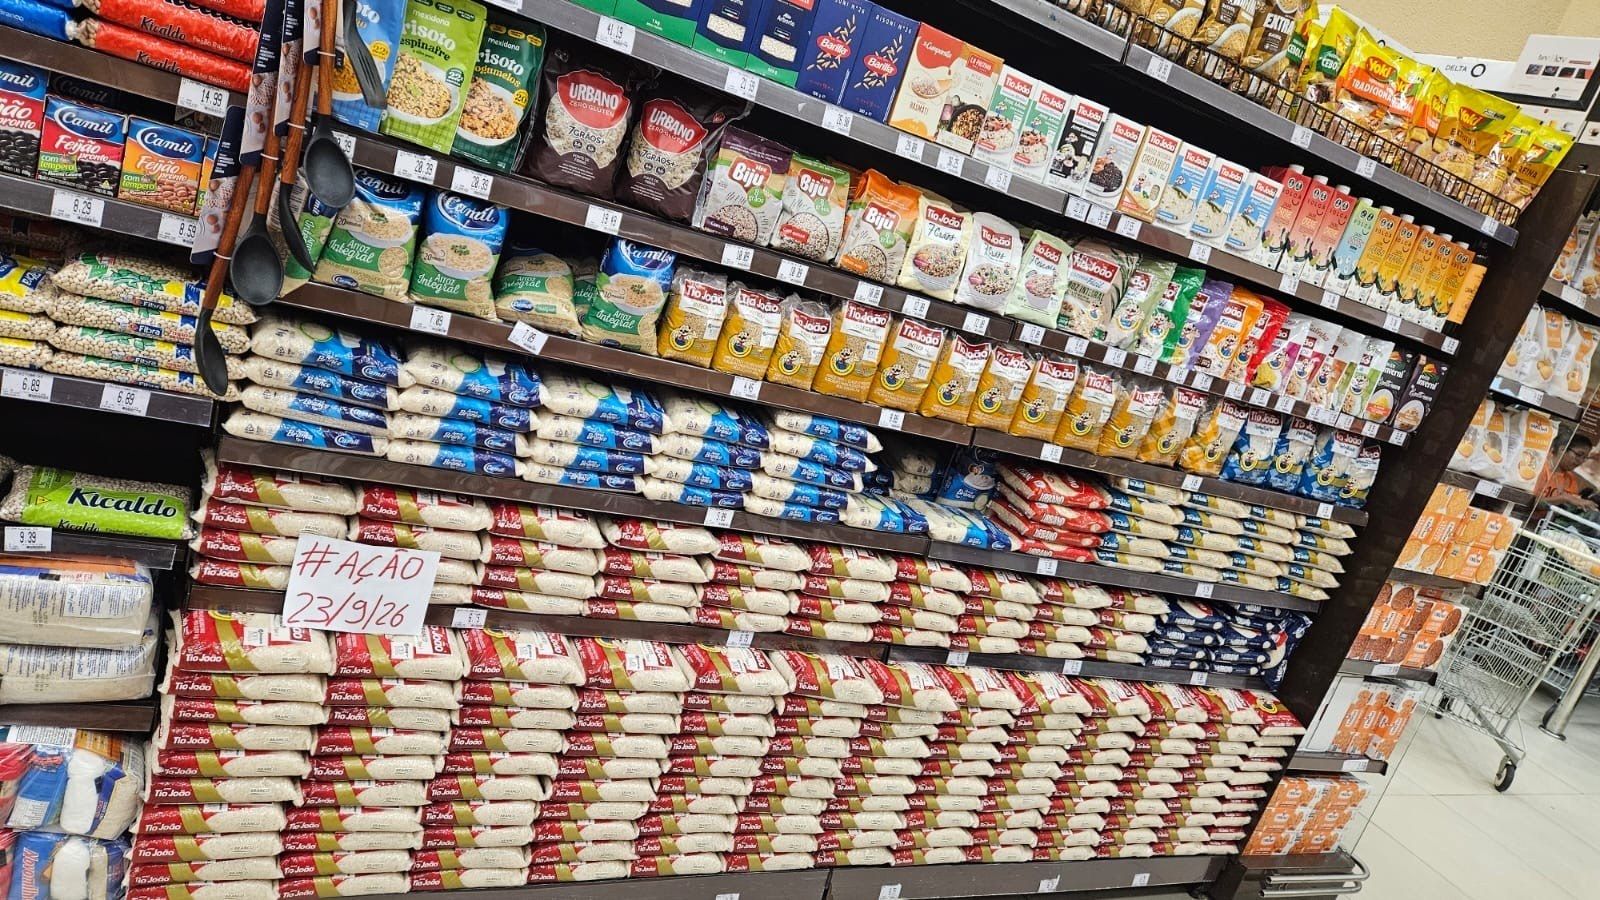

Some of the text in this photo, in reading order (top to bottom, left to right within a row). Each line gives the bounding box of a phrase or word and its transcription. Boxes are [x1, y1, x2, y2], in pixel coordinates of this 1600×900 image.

[401, 20, 457, 51] risoto
[820, 38, 850, 56] Barilla
[867, 57, 896, 74] Barilla
[1369, 58, 1393, 78] Yoki
[1444, 64, 1468, 72] DELTA
[60, 78, 109, 103] Camil
[1015, 81, 1031, 95] João
[201, 88, 223, 107] 14.99
[569, 82, 620, 110] URBANO
[569, 100, 589, 110] ZERO
[61, 111, 114, 135] Camil
[650, 108, 696, 141] URBANO
[1123, 127, 1139, 141] João
[54, 134, 102, 155] Feijão
[143, 131, 194, 154] Camil
[40, 153, 60, 163] com
[77, 152, 110, 163] pronto
[136, 154, 181, 175] Feijão
[122, 173, 141, 182] com
[732, 162, 764, 186] Biju
[121, 180, 156, 191] tempero
[355, 168, 407, 195] Camil
[799, 172, 829, 196] Biju
[73, 199, 91, 215] 8.29
[444, 196, 496, 223] Camil
[337, 217, 346, 226] 20
[866, 206, 894, 230] Biju
[928, 209, 962, 228] Tio João
[179, 222, 196, 238] 8.59
[328, 238, 375, 264] Integral
[347, 239, 370, 253] Arroz
[624, 243, 674, 264] Camil
[334, 276, 357, 286] Camil
[417, 273, 460, 295] Integral
[433, 273, 456, 286] Arroz
[596, 310, 634, 329] Integral
[614, 310, 632, 320] Arroz
[138, 324, 162, 336] Fibra
[904, 325, 940, 345] Tio João
[135, 357, 157, 366] Fibra
[365, 367, 387, 378] Camil
[22, 379, 41, 392] 6.89
[116, 391, 135, 405] 6.89
[354, 388, 375, 398] Camil
[337, 436, 359, 446] Camil
[68, 488, 177, 517] Kicaldo
[366, 504, 397, 516] Tio João
[211, 512, 246, 525] Tio João
[20, 531, 37, 544] 9.39
[206, 541, 240, 552] Tio João
[287, 592, 409, 630] 23/9/26
[186, 654, 222, 663] Tio João
[176, 682, 211, 692] Tio João
[343, 692, 363, 700] João
[173, 736, 209, 746] Tio João
[155, 788, 191, 799] Tio João
[139, 848, 175, 858] Tio João
[296, 865, 314, 873] João
